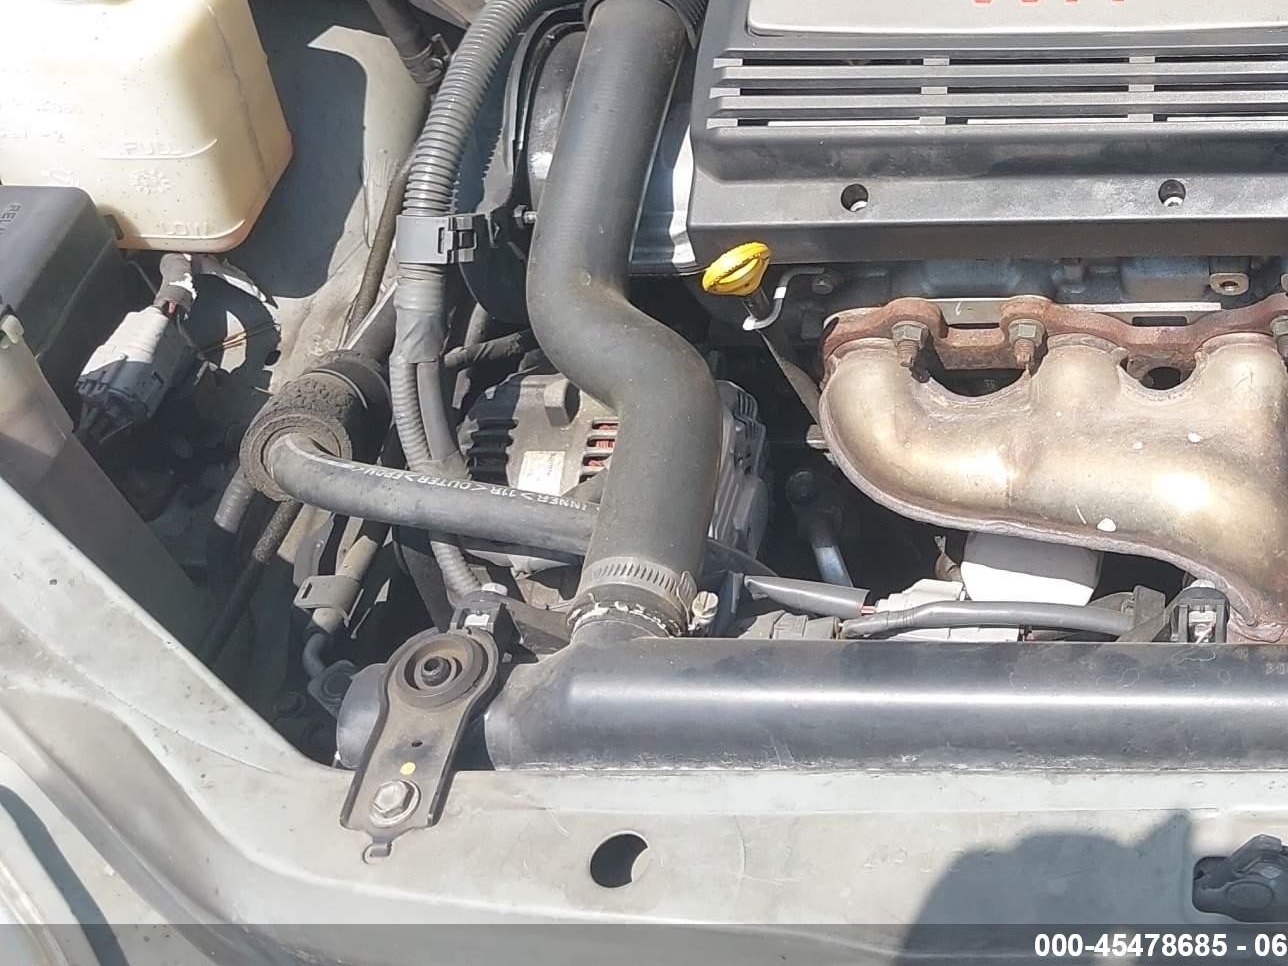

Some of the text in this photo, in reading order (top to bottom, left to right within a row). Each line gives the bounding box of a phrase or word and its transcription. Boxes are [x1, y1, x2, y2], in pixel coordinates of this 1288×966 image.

[122, 140, 184, 156] FULL
[160, 220, 209, 237] LOW
[417, 474, 470, 492] OUTER
[536, 494, 590, 512] INNER
